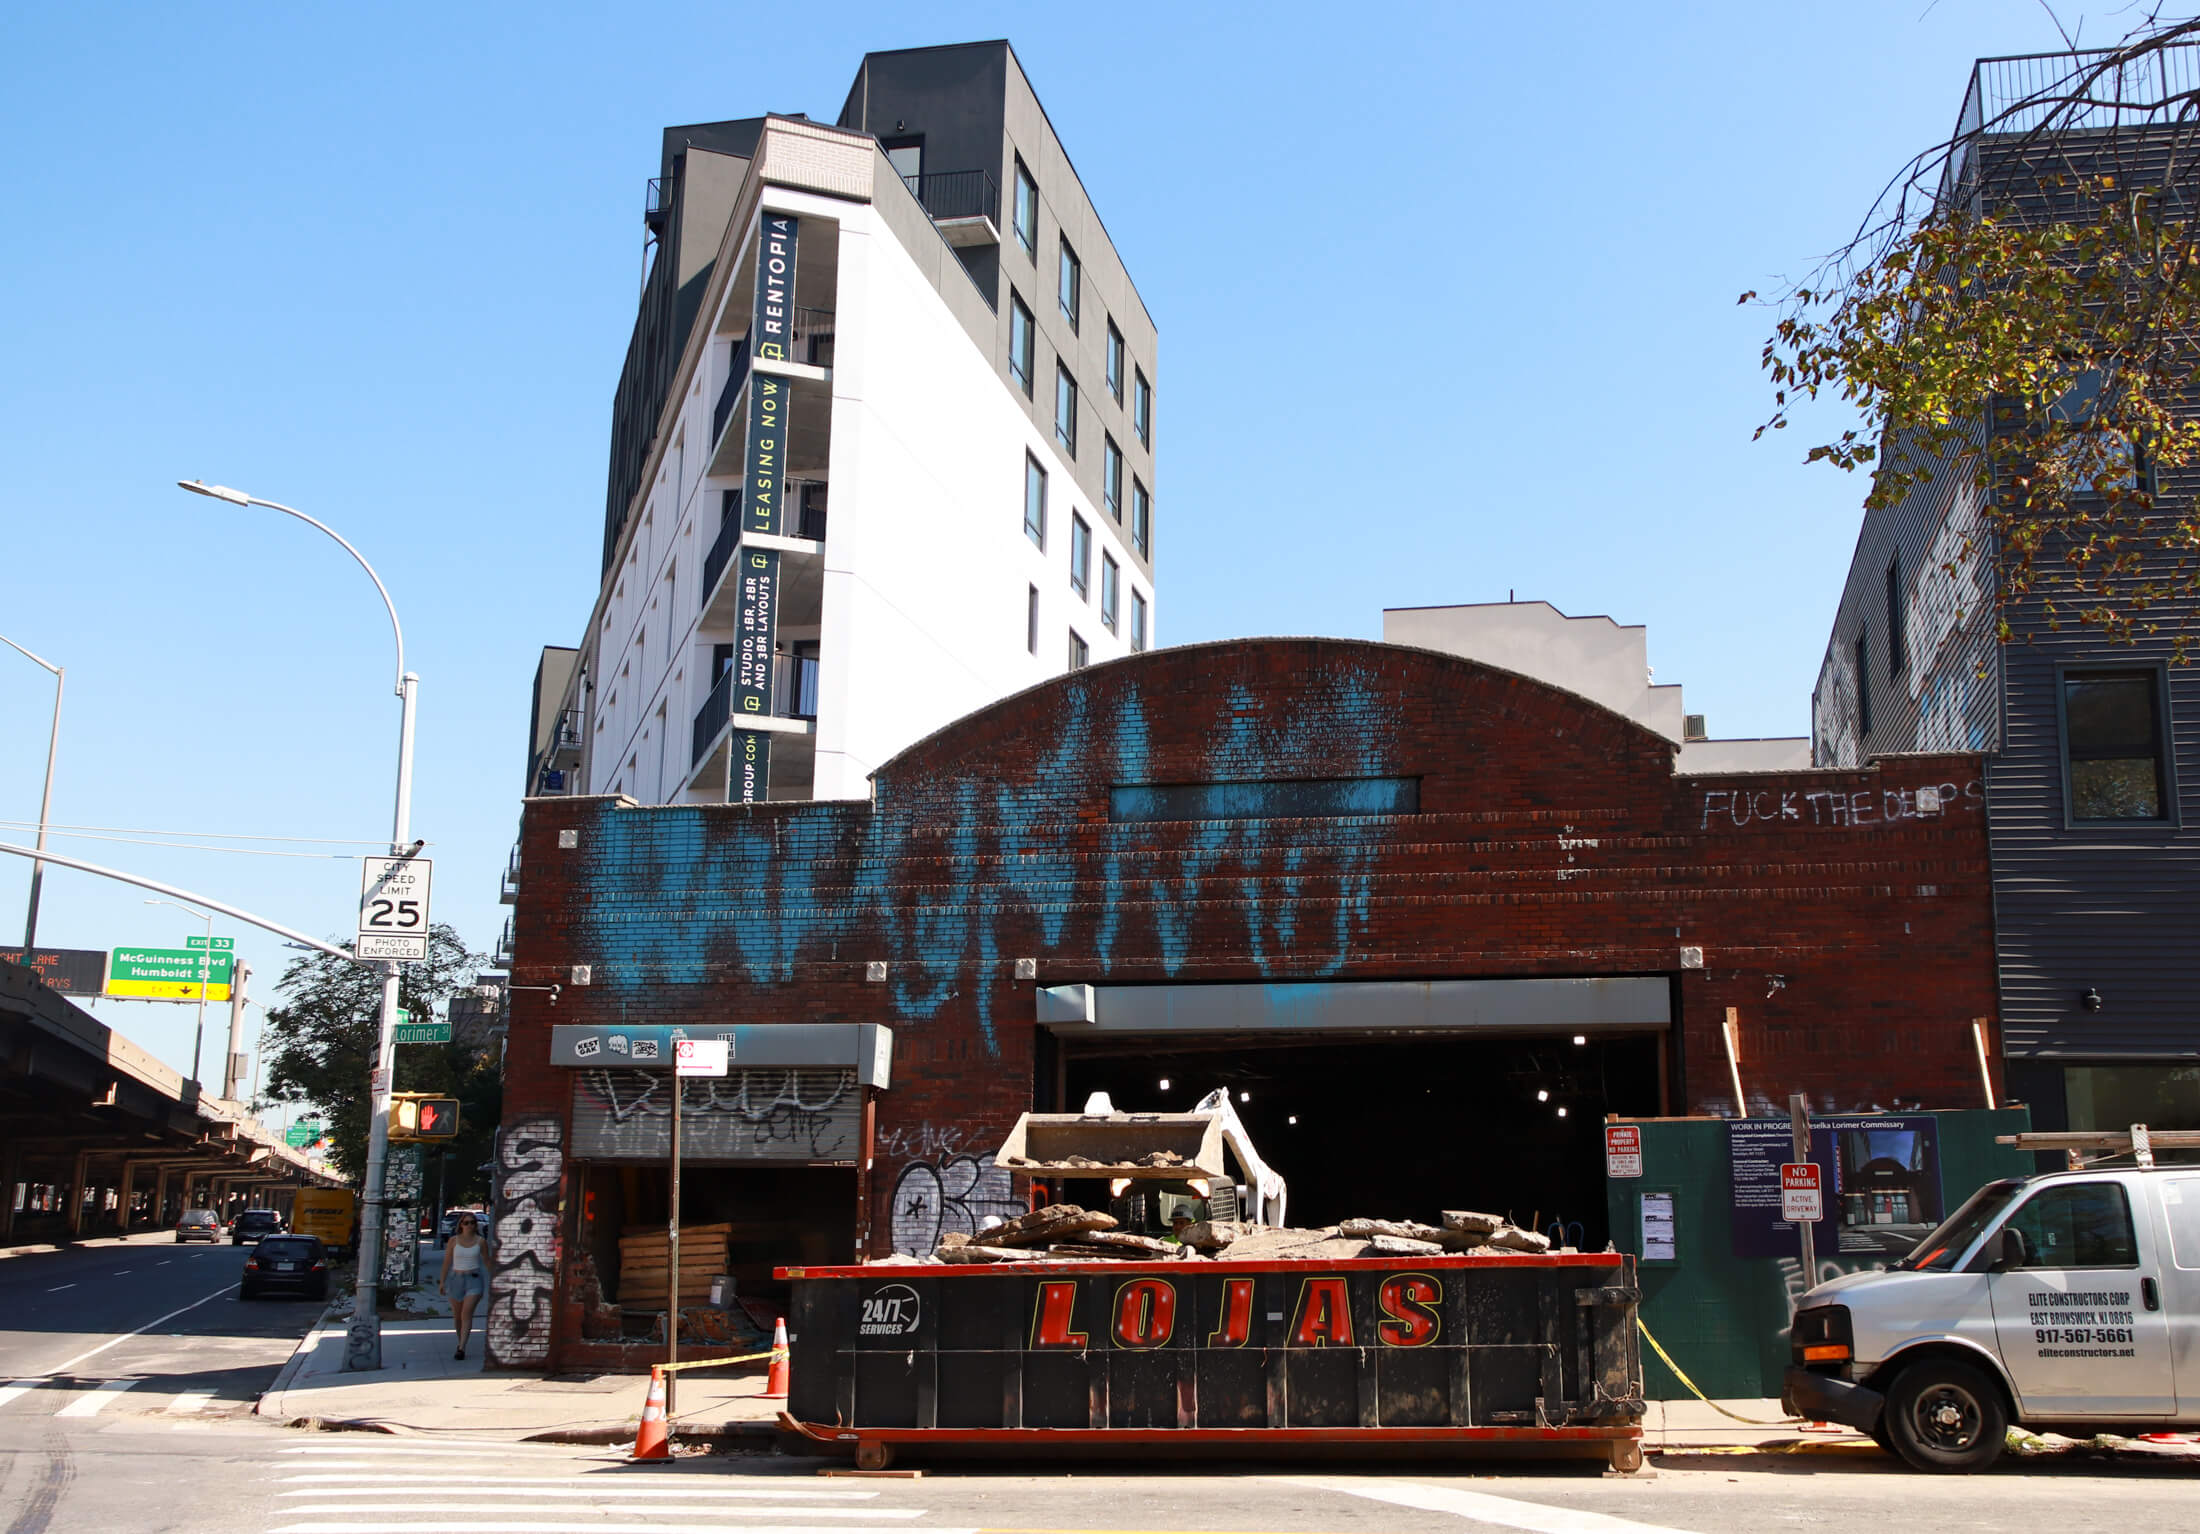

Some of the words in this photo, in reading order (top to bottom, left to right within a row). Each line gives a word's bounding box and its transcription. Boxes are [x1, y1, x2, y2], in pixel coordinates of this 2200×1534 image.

[765, 220, 788, 334] RENTOPIA
[761, 379, 778, 427] NOW
[755, 439, 775, 531] LEASING
[746, 577, 757, 601] 2BR
[757, 576, 770, 632] LAYOUTS
[744, 605, 756, 631] 1BR,
[756, 636, 768, 660] 3BR
[741, 636, 754, 686] STUDIO,
[754, 663, 766, 690] AND
[1700, 790, 1800, 829] FUCK
[1805, 791, 1880, 827] THE
[384, 862, 411, 872] CITY
[377, 874, 416, 884] SPEED
[380, 886, 411, 895] LIMIT
[369, 899, 420, 928] 25
[215, 939, 230, 948] 33
[375, 938, 410, 947] PHOTO
[119, 953, 194, 965] McGuinness
[363, 947, 420, 956] ENFORCED
[131, 967, 192, 979] Humboldt
[395, 1025, 439, 1041] Lorimer
[1730, 1122, 1753, 1131] WORK
[1754, 1122, 1762, 1130] IN
[1763, 1122, 1792, 1130] PROGRE
[1808, 1121, 1831, 1129] eselka
[1832, 1121, 1860, 1129] Lorimer
[1860, 1120, 1904, 1130] Commissary
[1792, 1167, 1808, 1177] NO
[1785, 1178, 1816, 1188] PARKING
[1791, 1195, 1813, 1203] ACTIVE
[1786, 1204, 1817, 1213] DRIVEWAY
[2028, 1292, 2048, 1307] ELITE
[2048, 1292, 2108, 1306] CONSTRUCTORS
[2109, 1291, 2130, 1306] CORP
[862, 1298, 901, 1323] 24/7
[1029, 1272, 1443, 1352] LOJAS
[2030, 1312, 2049, 1325] EAST
[2049, 1311, 2099, 1326] BRUNSWICK,
[2099, 1311, 2108, 1325] NJ
[859, 1324, 903, 1335] SERVICES
[2035, 1328, 2134, 1344] 917-567-5661
[2038, 1348, 2135, 1358] eliteconstructors.net
